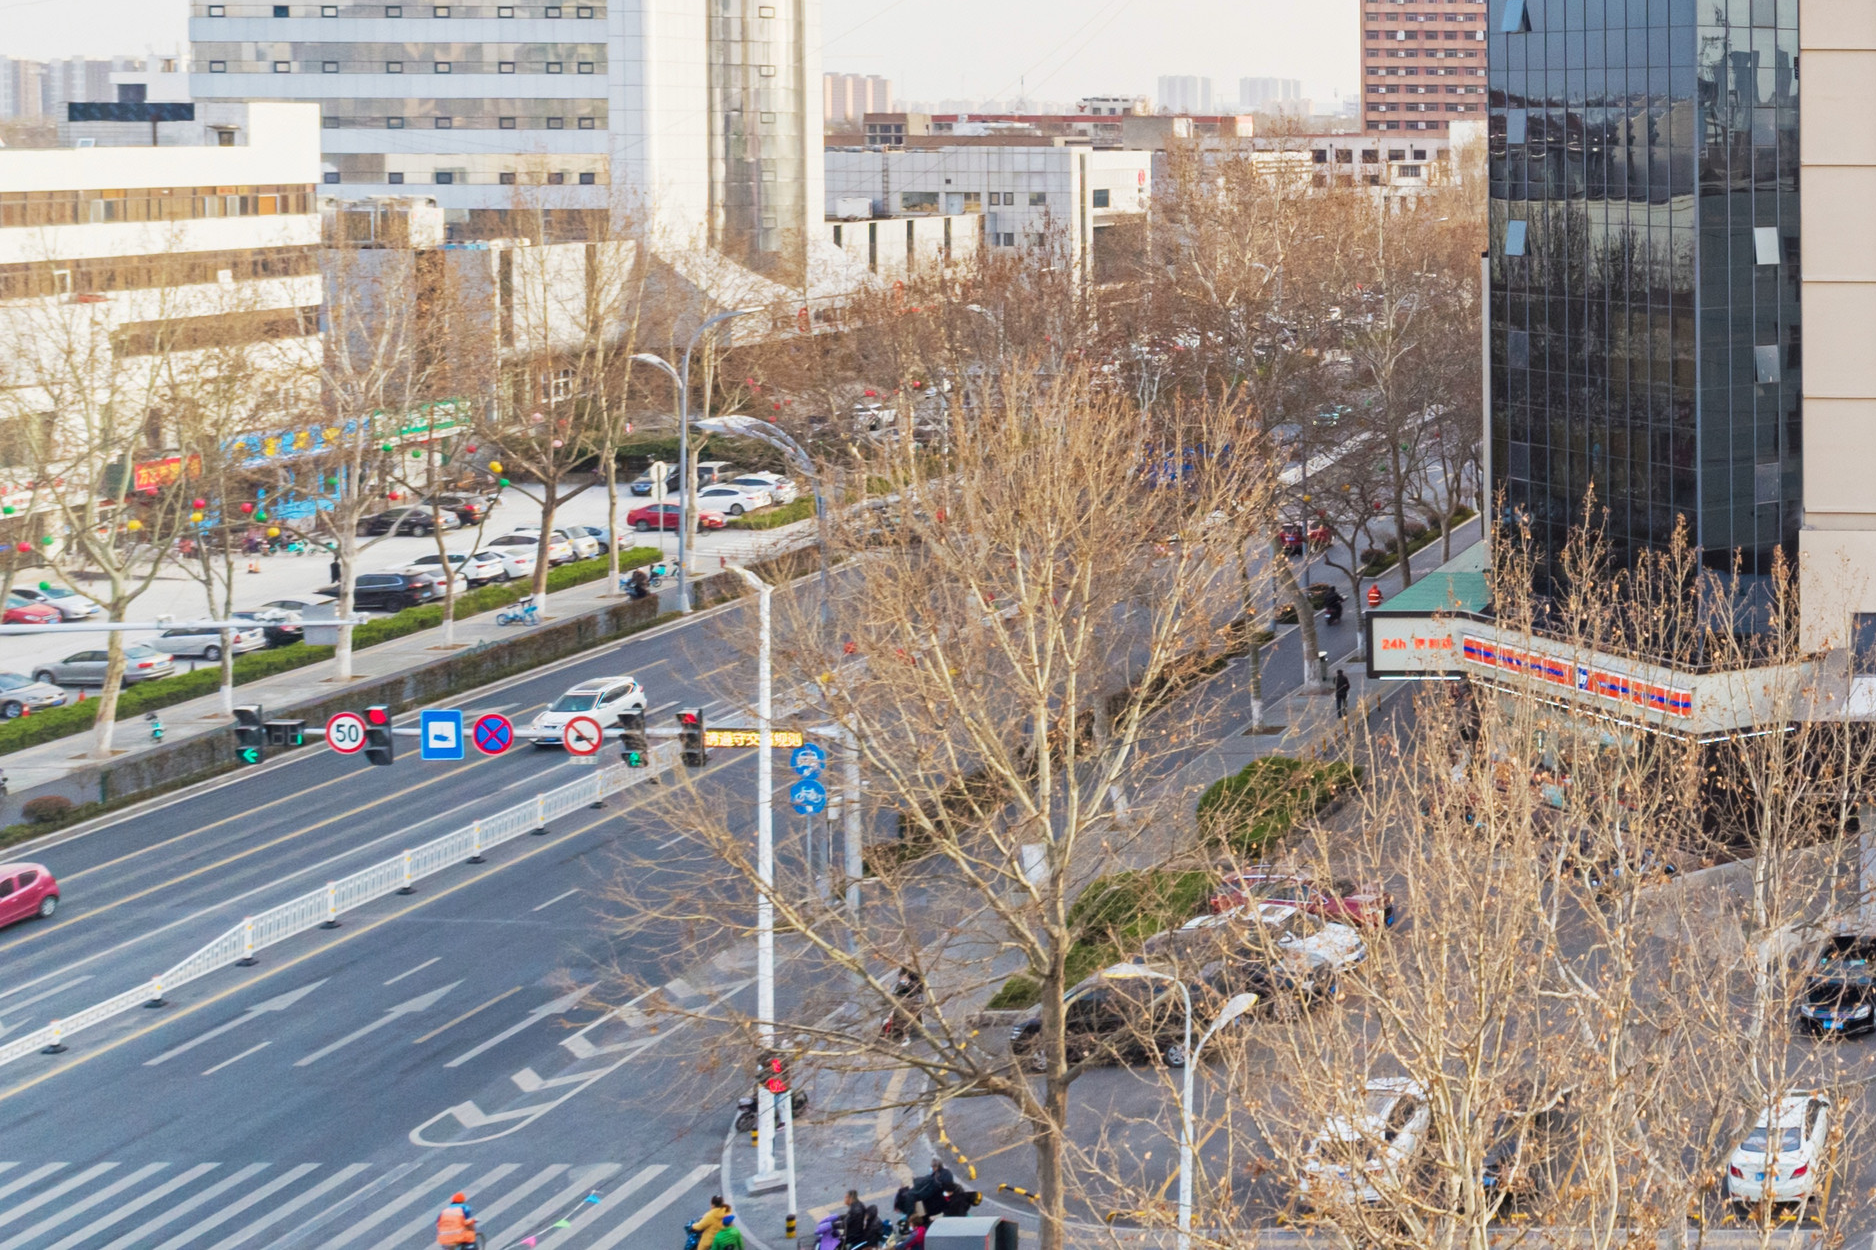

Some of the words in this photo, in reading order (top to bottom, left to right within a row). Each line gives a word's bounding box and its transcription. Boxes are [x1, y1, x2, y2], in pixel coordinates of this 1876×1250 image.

[1381, 638, 1407, 650] 24h
[335, 724, 359, 743] 50
[705, 731, 802, 746] 请遵守交规则
